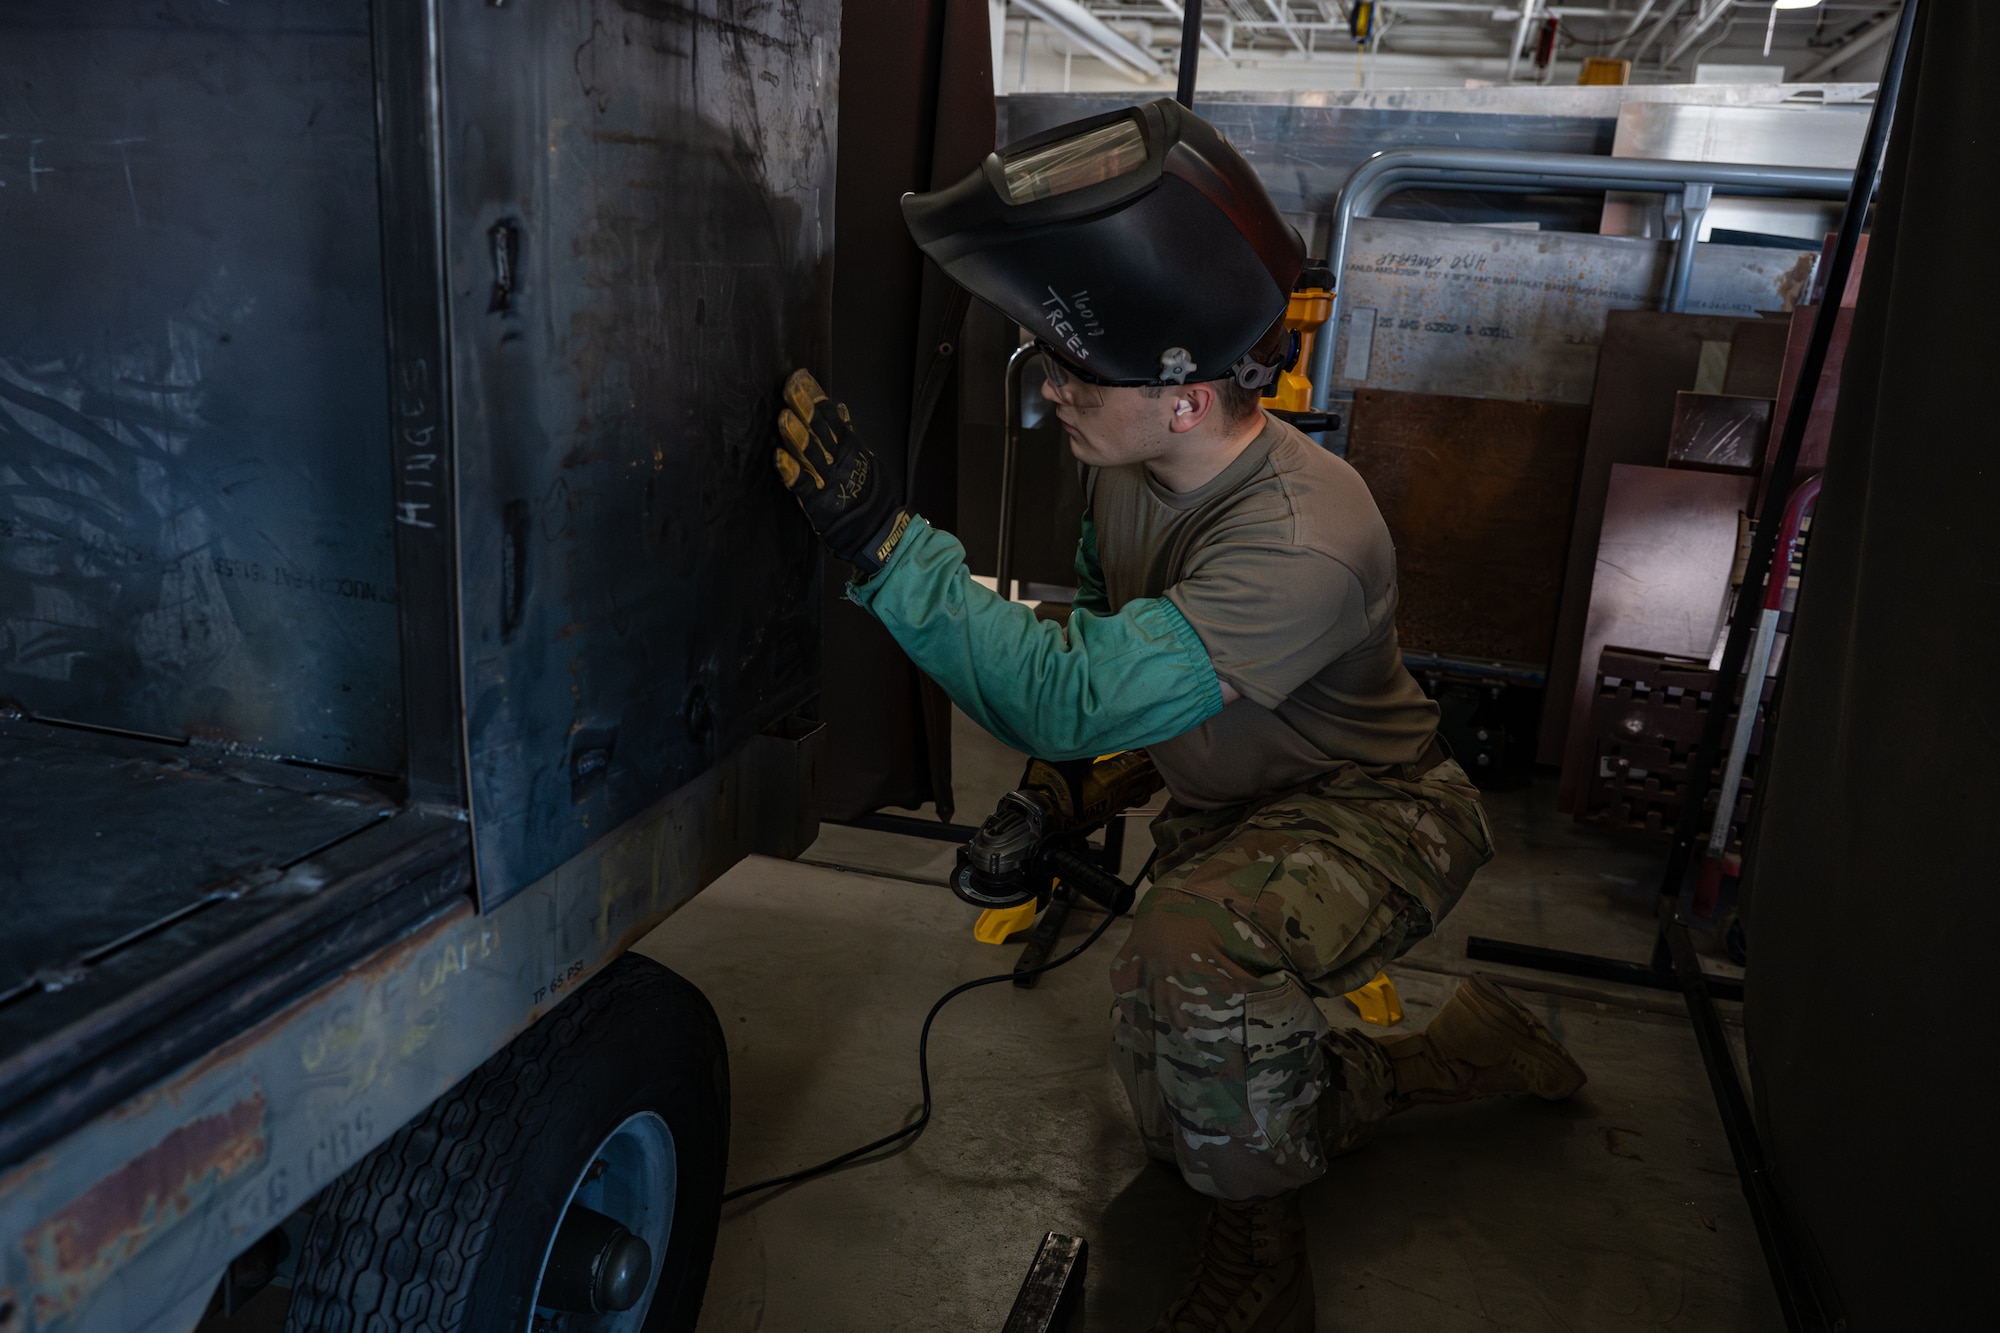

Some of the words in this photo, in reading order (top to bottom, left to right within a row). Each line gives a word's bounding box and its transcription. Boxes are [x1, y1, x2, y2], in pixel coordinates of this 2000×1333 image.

[1042, 285, 1090, 361] TREES
[395, 358, 437, 529] HINGES
[837, 458, 861, 511] FLEX
[550, 974, 564, 993] 65
[567, 959, 584, 980] PSI
